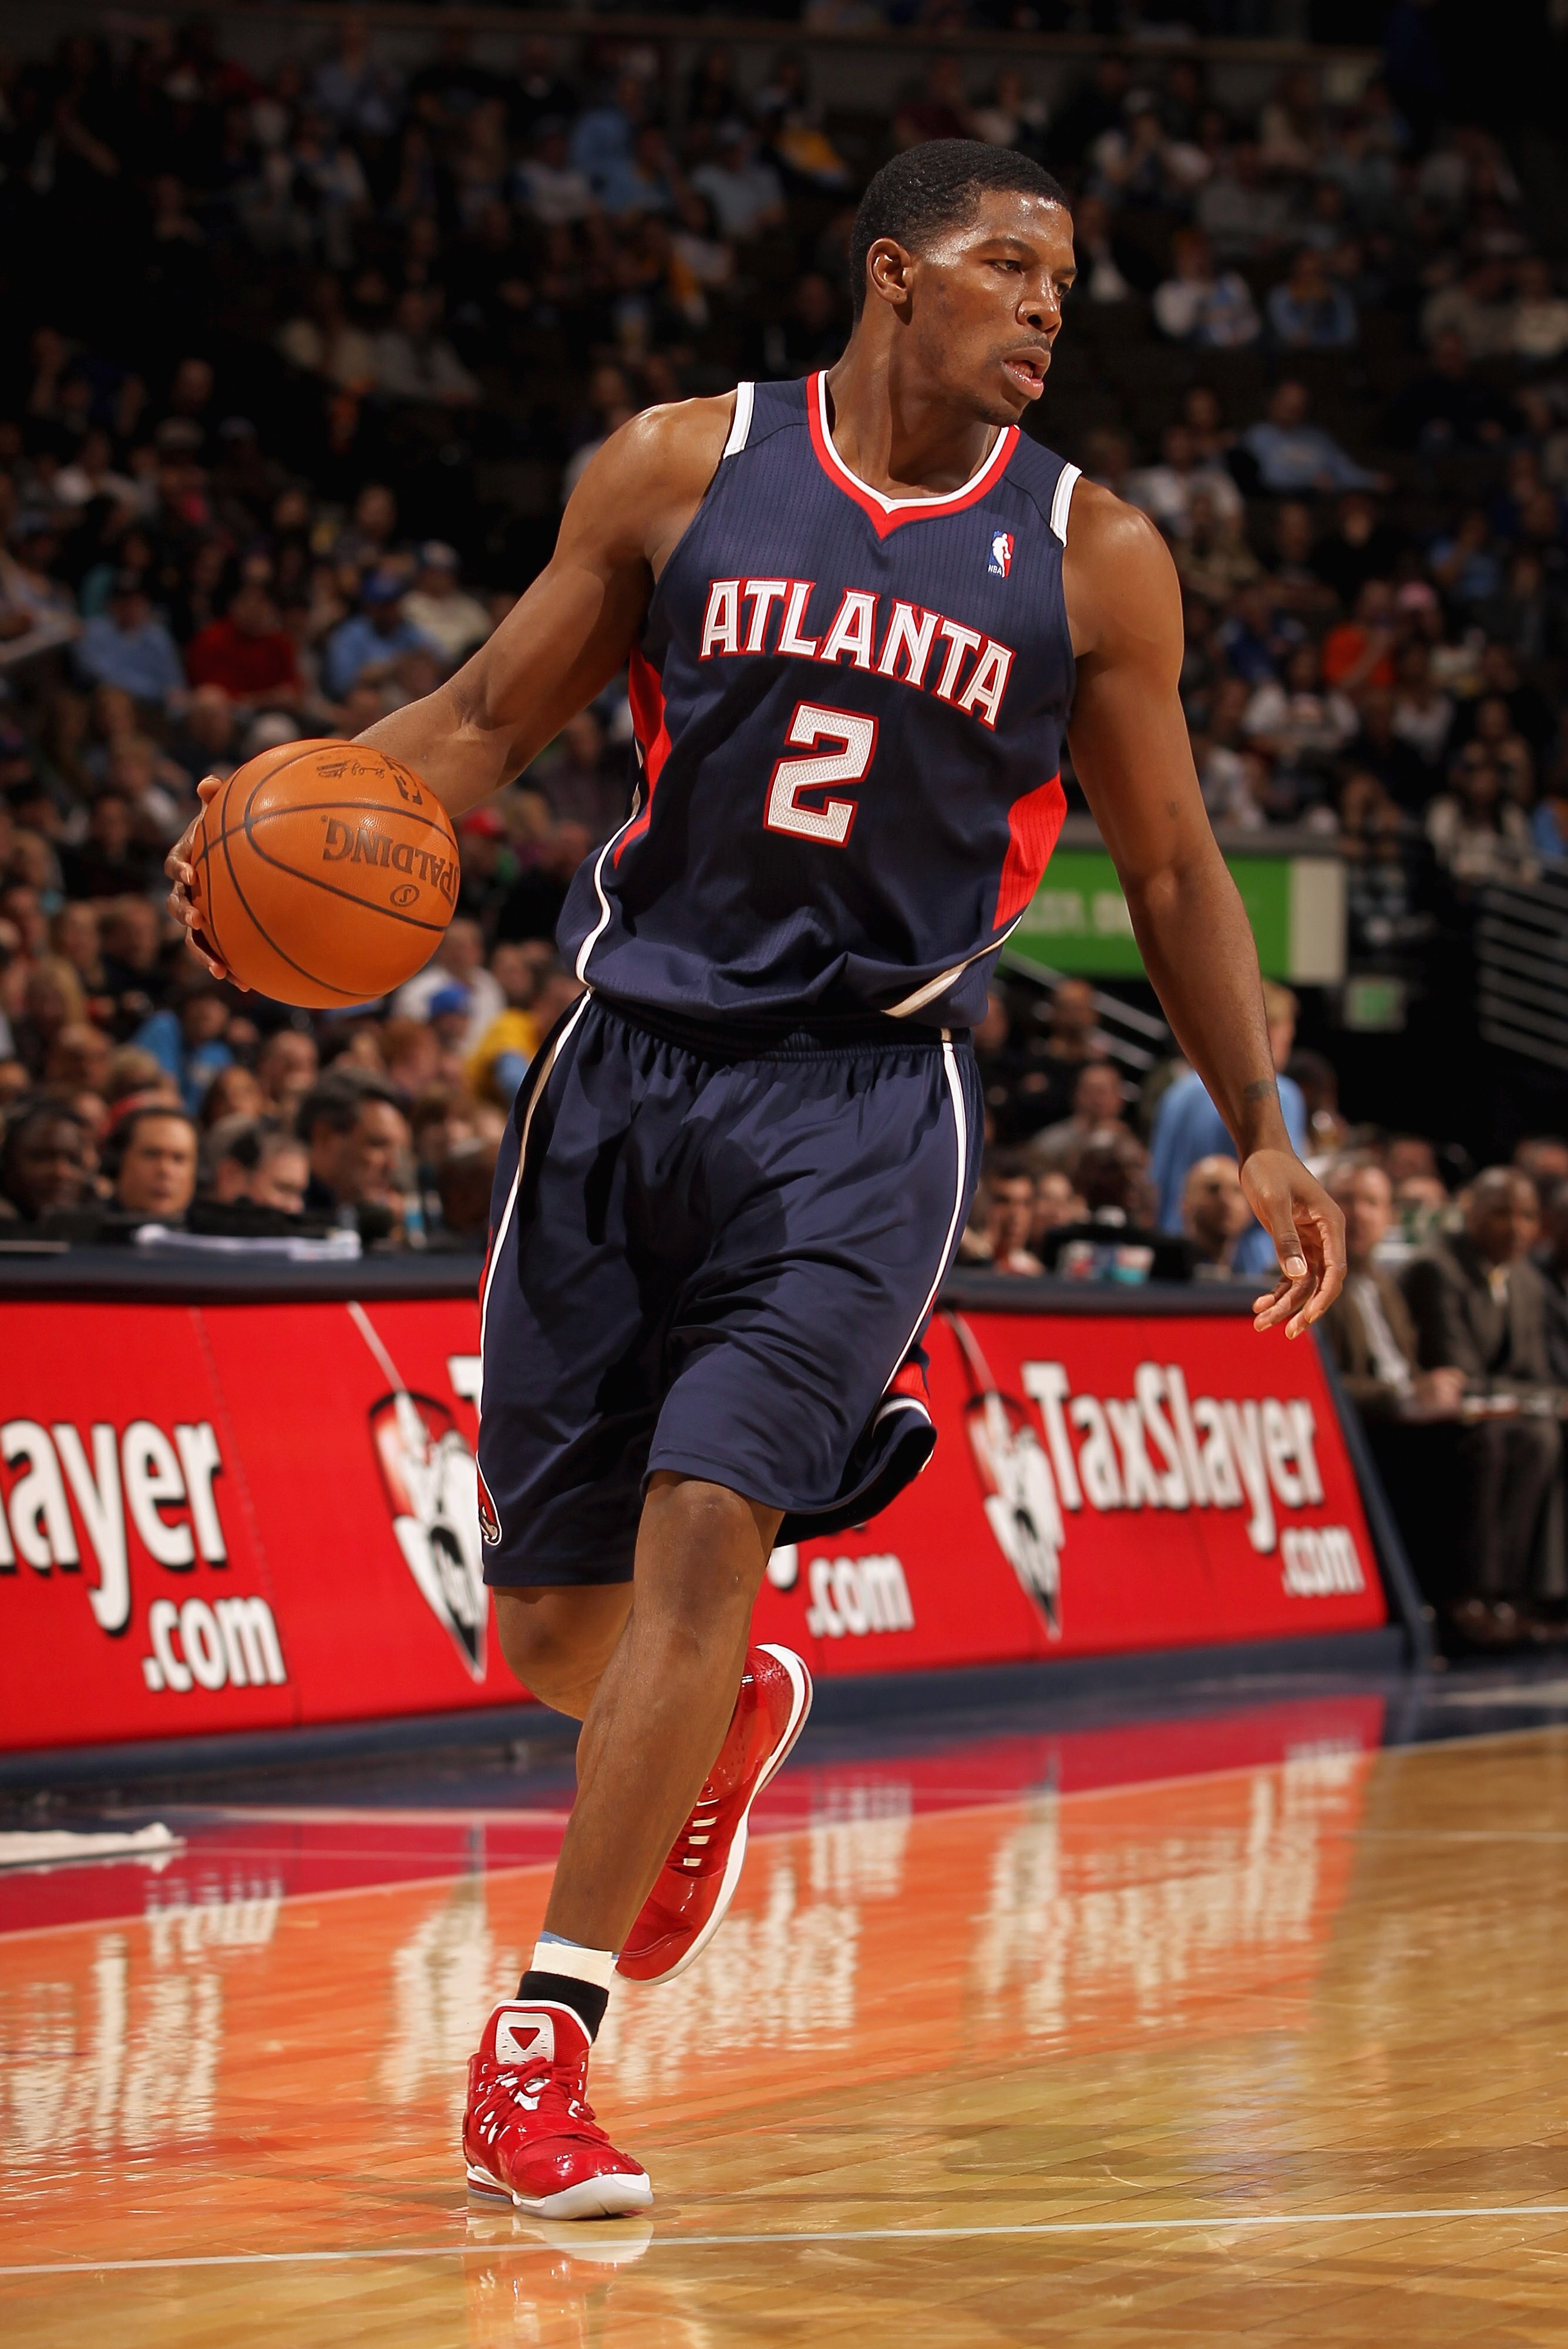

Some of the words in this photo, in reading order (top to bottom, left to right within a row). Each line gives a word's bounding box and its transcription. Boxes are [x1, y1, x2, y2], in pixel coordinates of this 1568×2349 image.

[988, 564, 1002, 575] NBA
[699, 577, 1015, 731] ATLANTA
[763, 700, 879, 848] 2
[323, 817, 460, 907] SPALDING
[1022, 1361, 1325, 1554] TaxSlayer
[805, 1553, 916, 1637] .com
[1280, 1525, 1365, 1596] .com
[142, 1596, 287, 1692] .com
